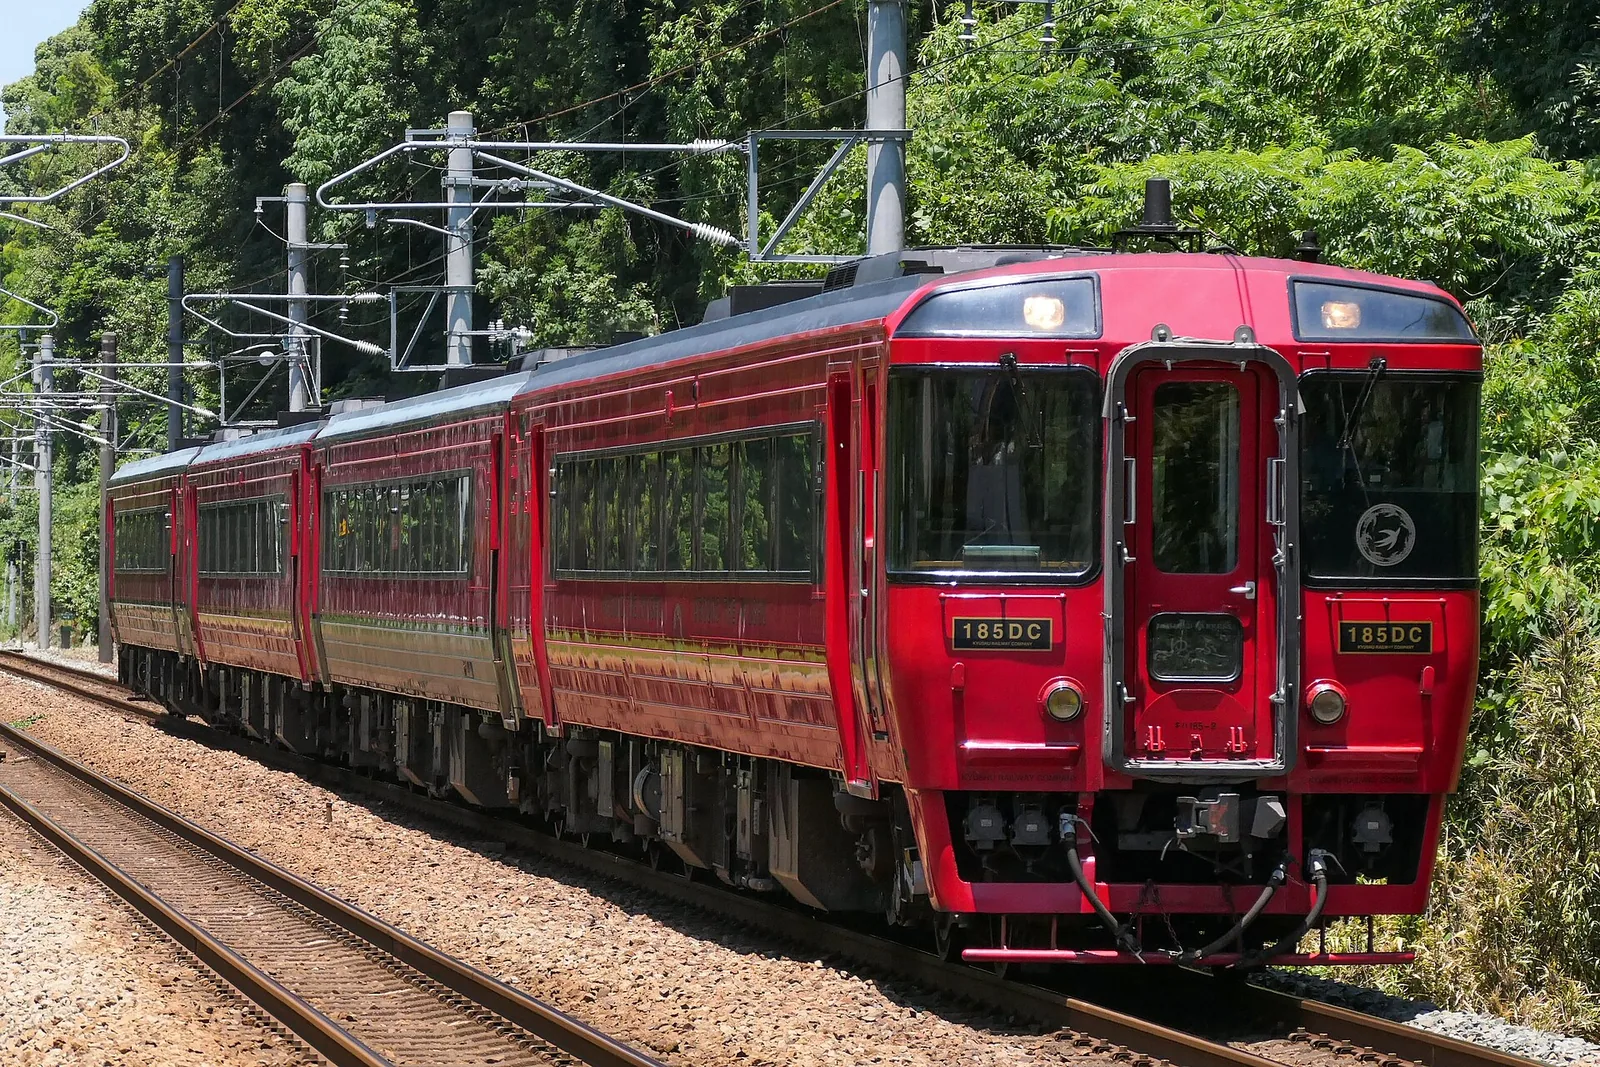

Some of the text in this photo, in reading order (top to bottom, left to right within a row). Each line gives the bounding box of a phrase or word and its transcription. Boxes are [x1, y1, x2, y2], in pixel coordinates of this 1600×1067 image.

[963, 623, 1041, 640] 185DC
[1348, 627, 1422, 643] 185DC
[998, 773, 1034, 781] RAILWAY
